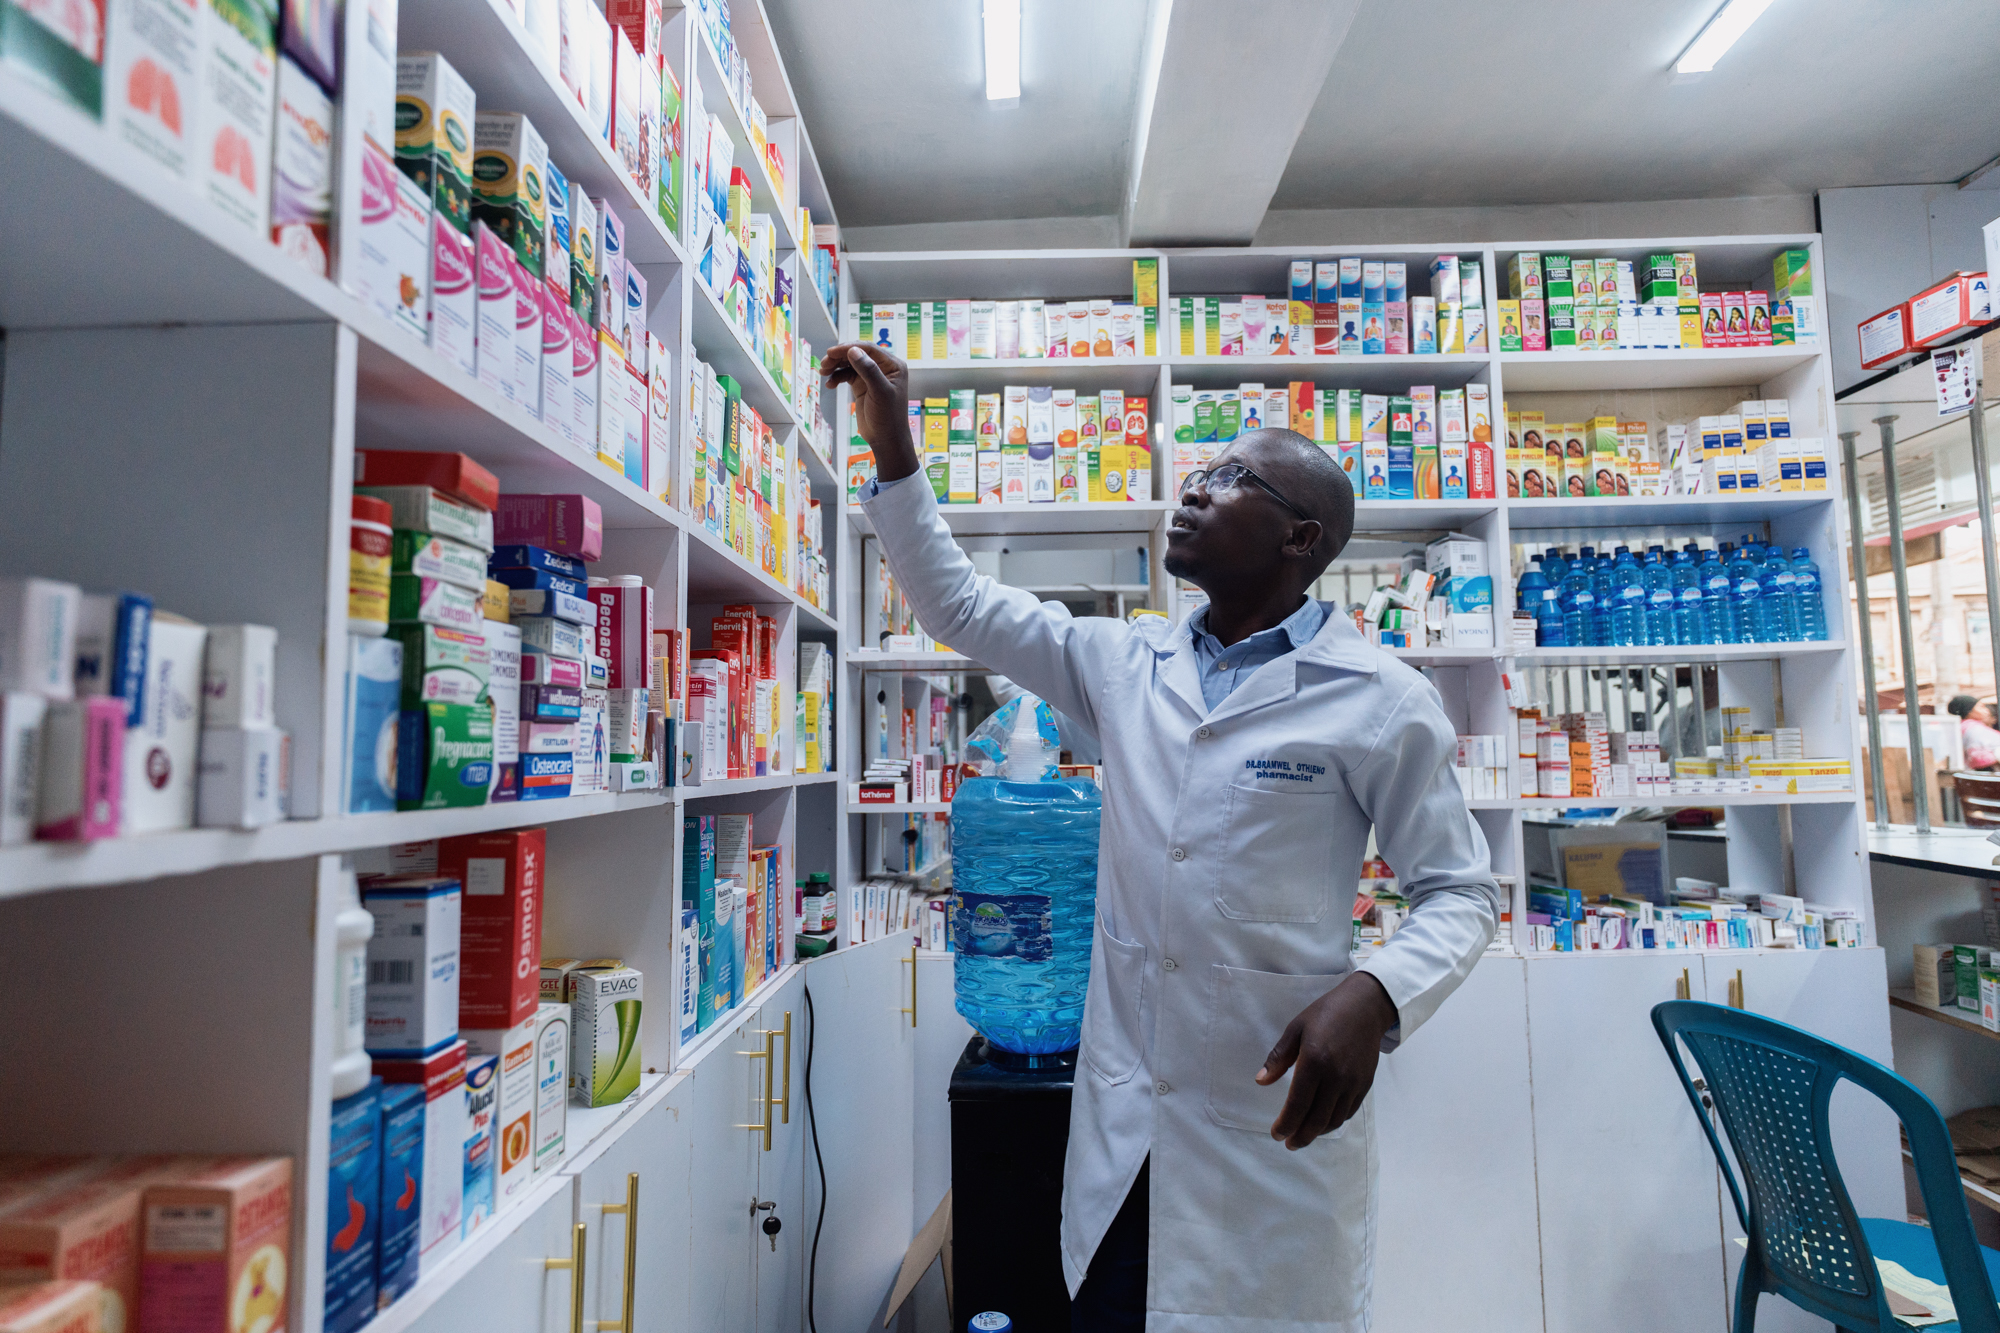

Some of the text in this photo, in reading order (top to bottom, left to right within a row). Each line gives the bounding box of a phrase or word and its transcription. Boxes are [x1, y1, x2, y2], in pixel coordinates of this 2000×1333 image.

[1128, 450, 1137, 488] ThioCarb
[1473, 448, 1481, 489] CHERICOF
[544, 553, 573, 572] Zedcal
[550, 577, 576, 593] Zedcal
[713, 623, 741, 631] Enervit
[531, 757, 572, 774] Osteocare
[1245, 760, 1326, 775] DR.BRAMWEL OTHIENO
[1761, 769, 1782, 777] Tanzol
[1809, 768, 1839, 776] Tanzol
[1256, 770, 1314, 782] pharmacist
[517, 850, 536, 980] Osmolax
[540, 979, 559, 989] GEL
[600, 977, 638, 993] EVAC
[683, 944, 691, 1015] Nilacid
